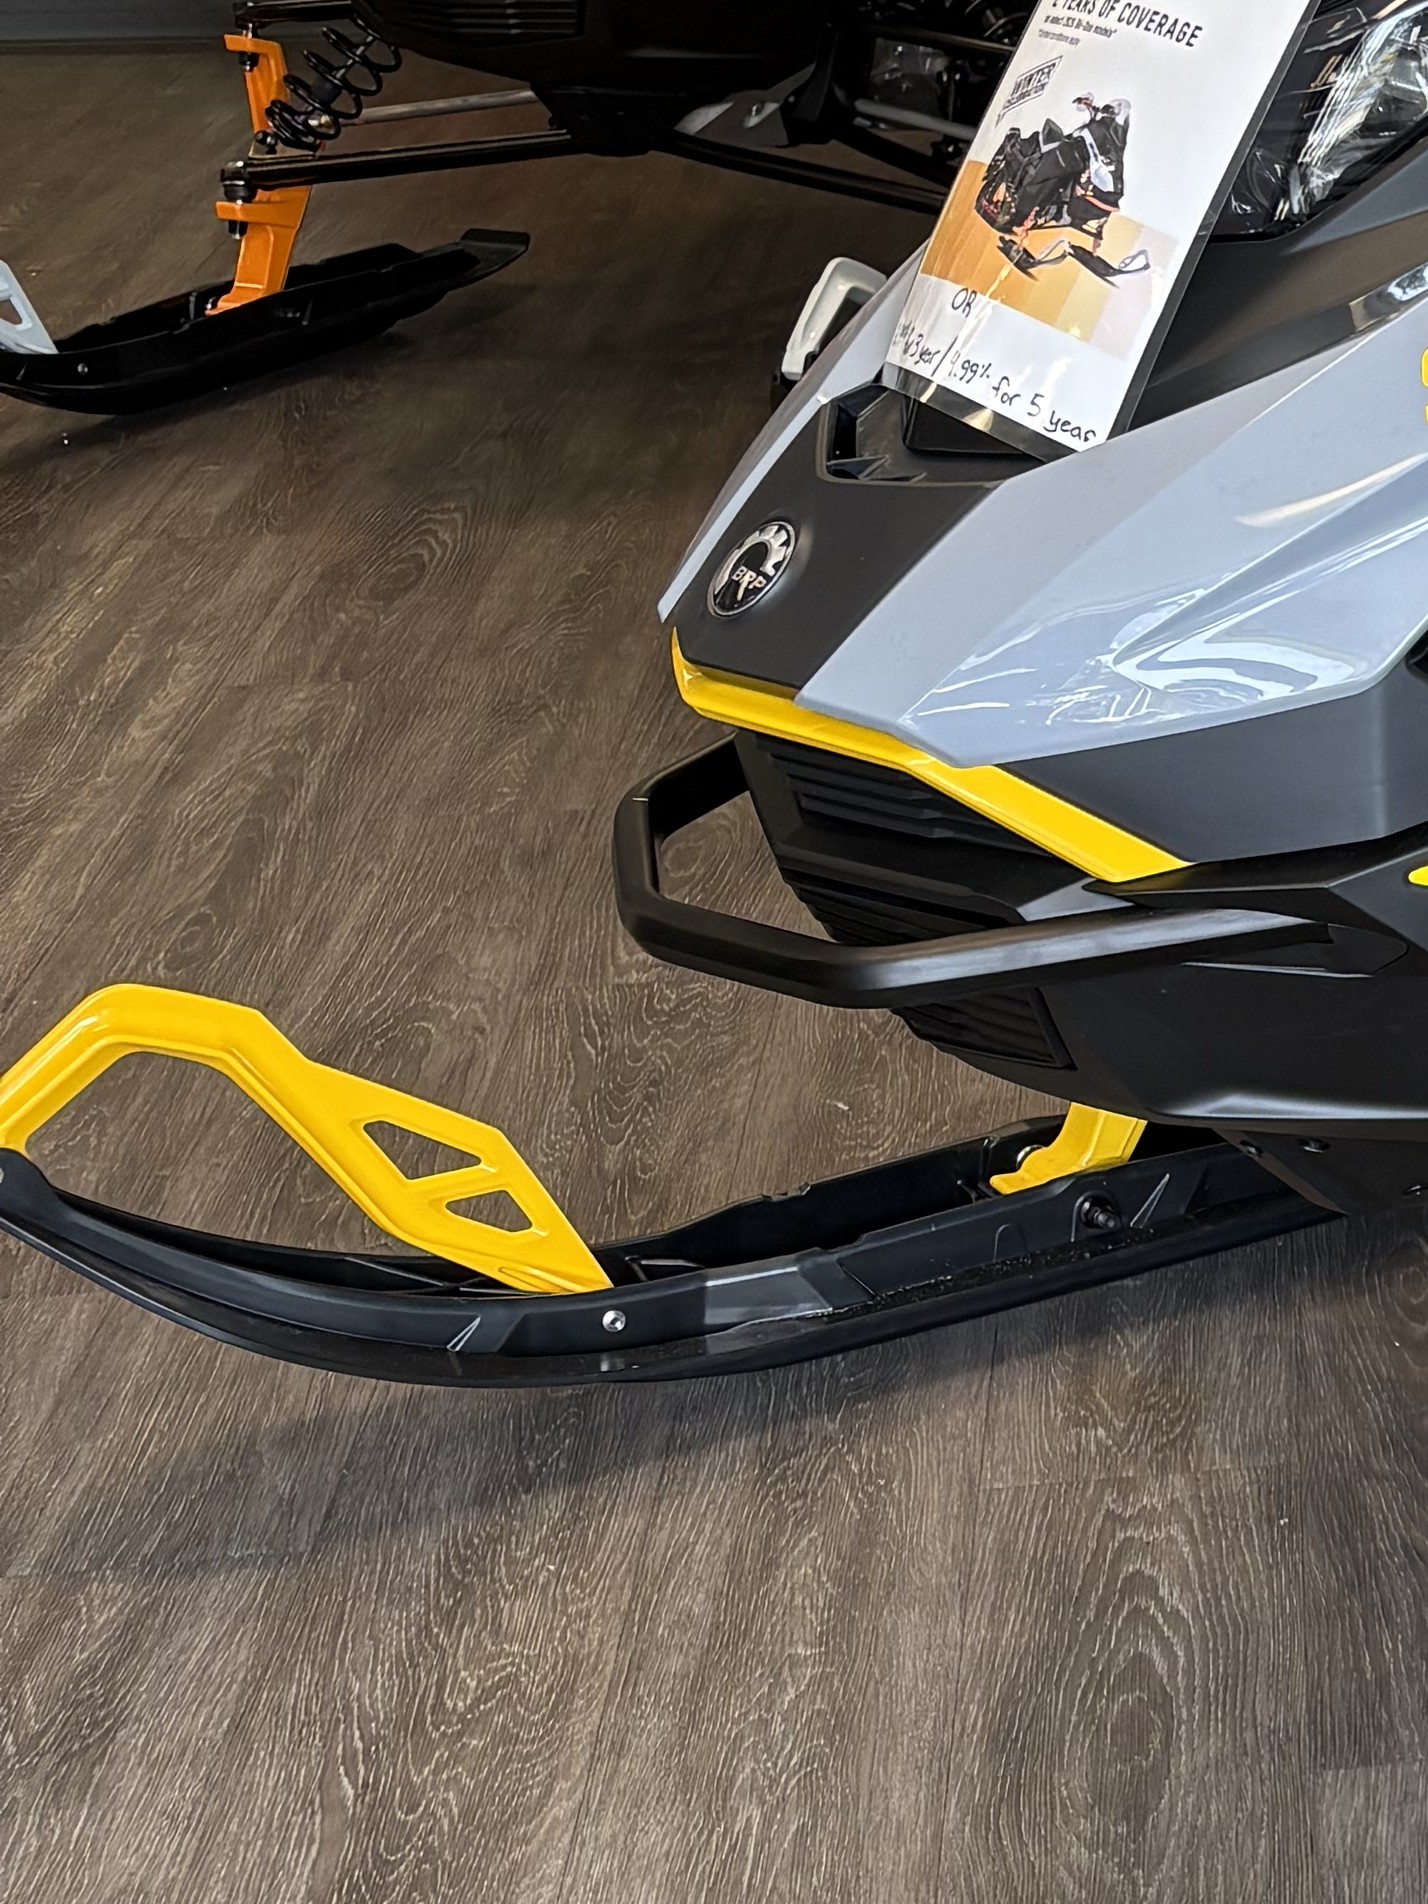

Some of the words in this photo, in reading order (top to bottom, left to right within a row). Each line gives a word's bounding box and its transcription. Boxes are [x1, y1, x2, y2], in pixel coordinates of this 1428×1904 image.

[1117, 1, 1204, 48] COVERAGE
[951, 287, 978, 318] OR
[991, 375, 1022, 407] for
[1026, 392, 1046, 418] 5
[731, 565, 767, 598] BRP
